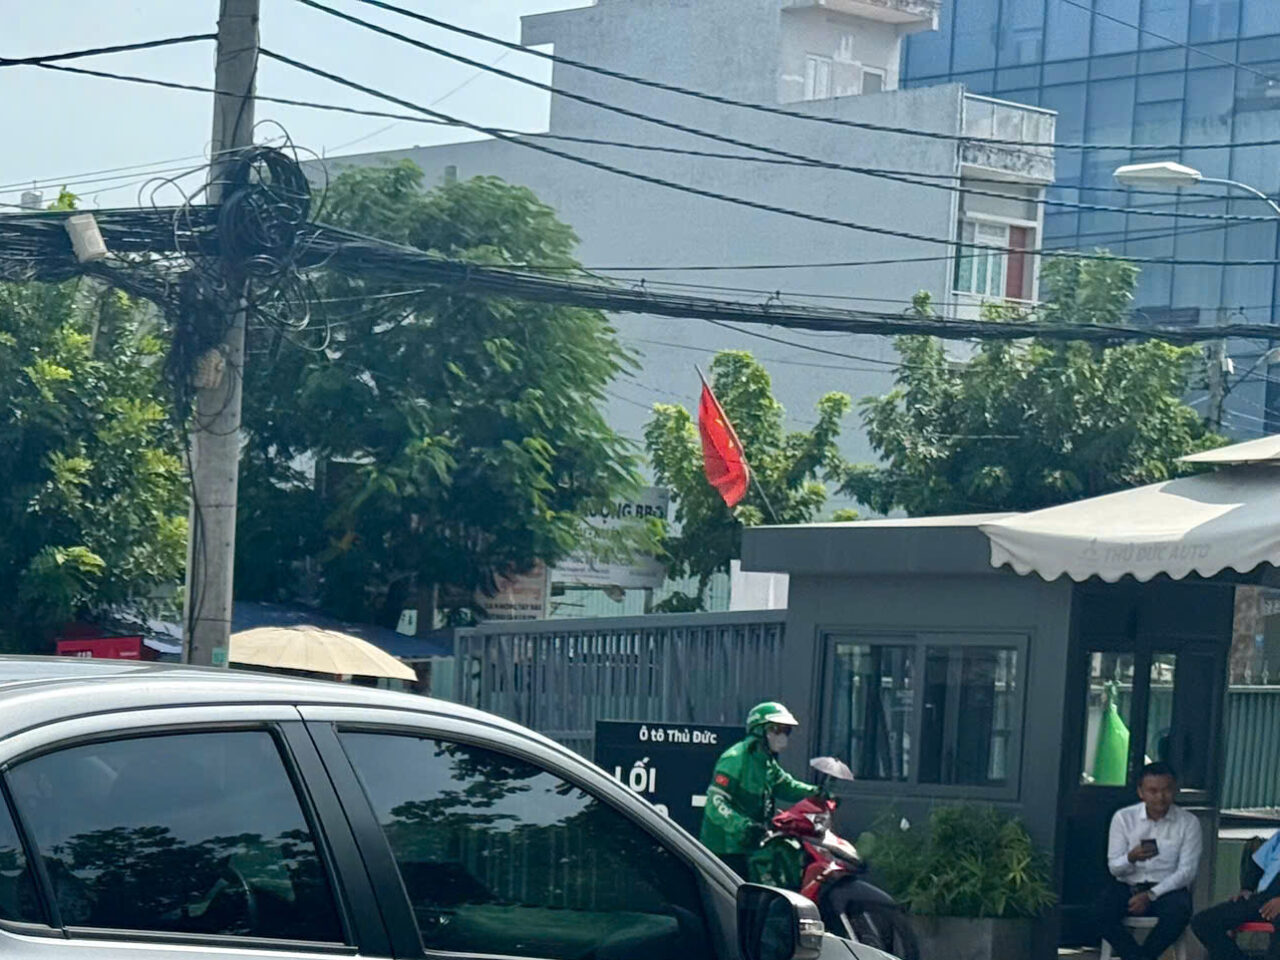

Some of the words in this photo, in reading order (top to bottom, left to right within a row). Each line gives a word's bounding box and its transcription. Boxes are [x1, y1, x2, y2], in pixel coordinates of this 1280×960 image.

[639, 725, 648, 741] Ô
[651, 728, 664, 742] tô
[667, 728, 690, 743] Thủ
[693, 730, 717, 744] Đức
